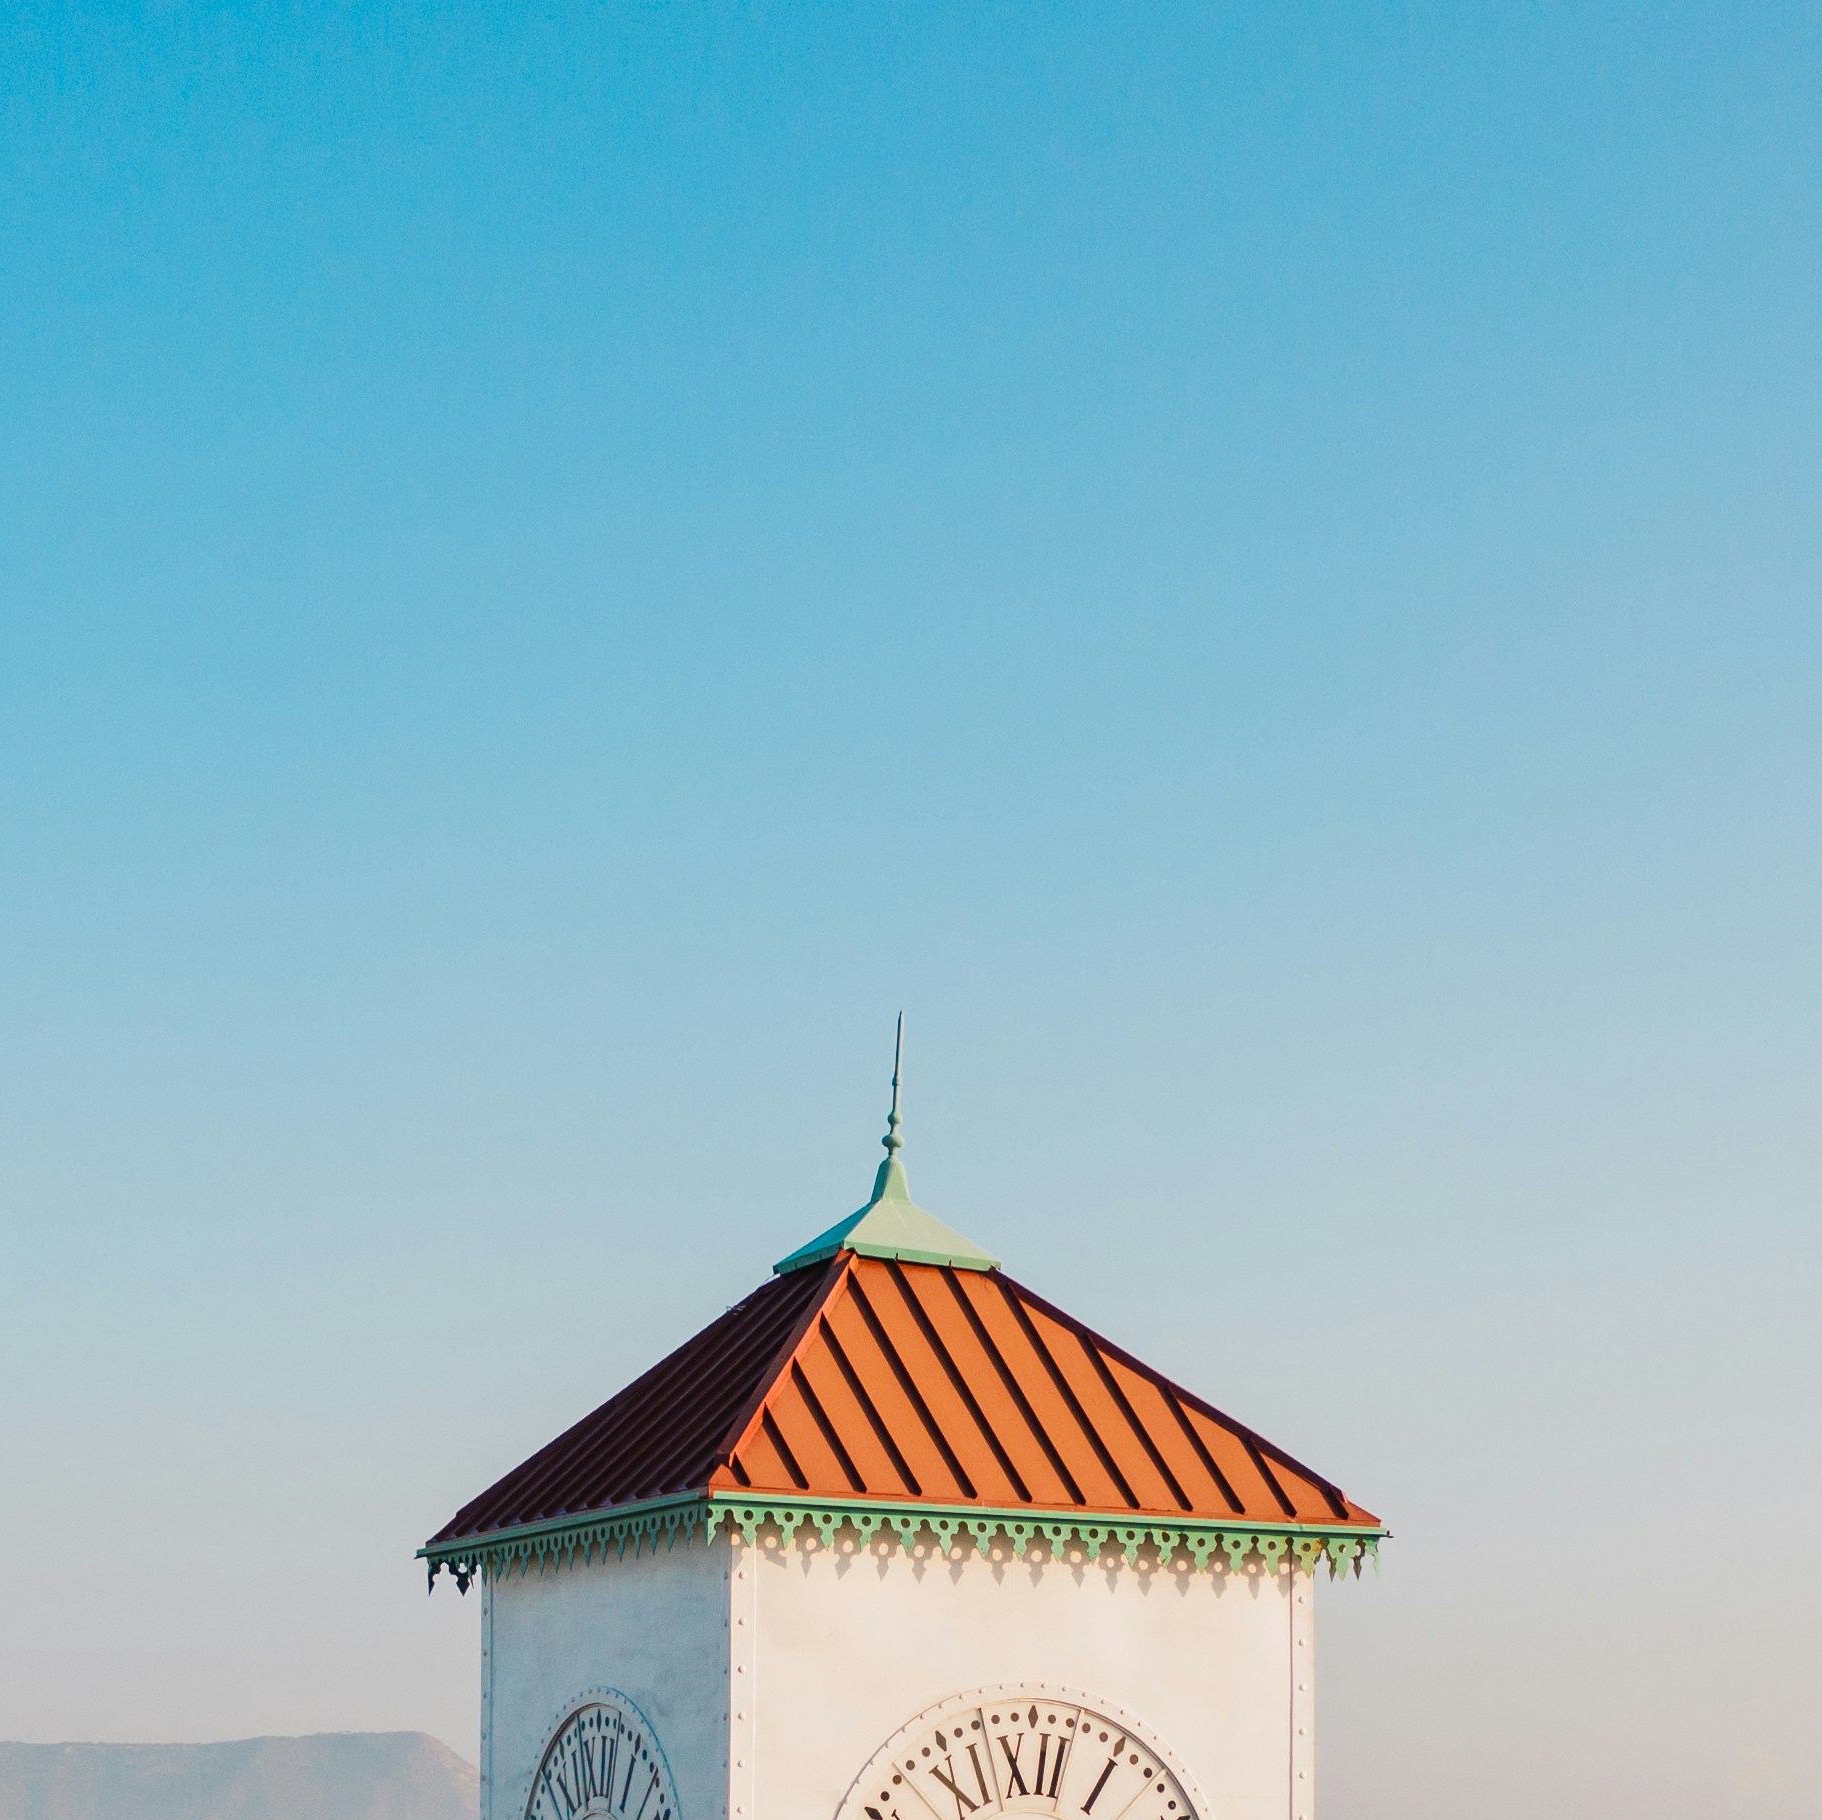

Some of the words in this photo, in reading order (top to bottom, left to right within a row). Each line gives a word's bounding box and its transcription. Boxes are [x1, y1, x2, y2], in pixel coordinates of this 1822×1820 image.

[583, 1735, 615, 1801] XII
[619, 1753, 637, 1814] I
[997, 1733, 1070, 1800] XII
[1081, 1757, 1118, 1816] I
